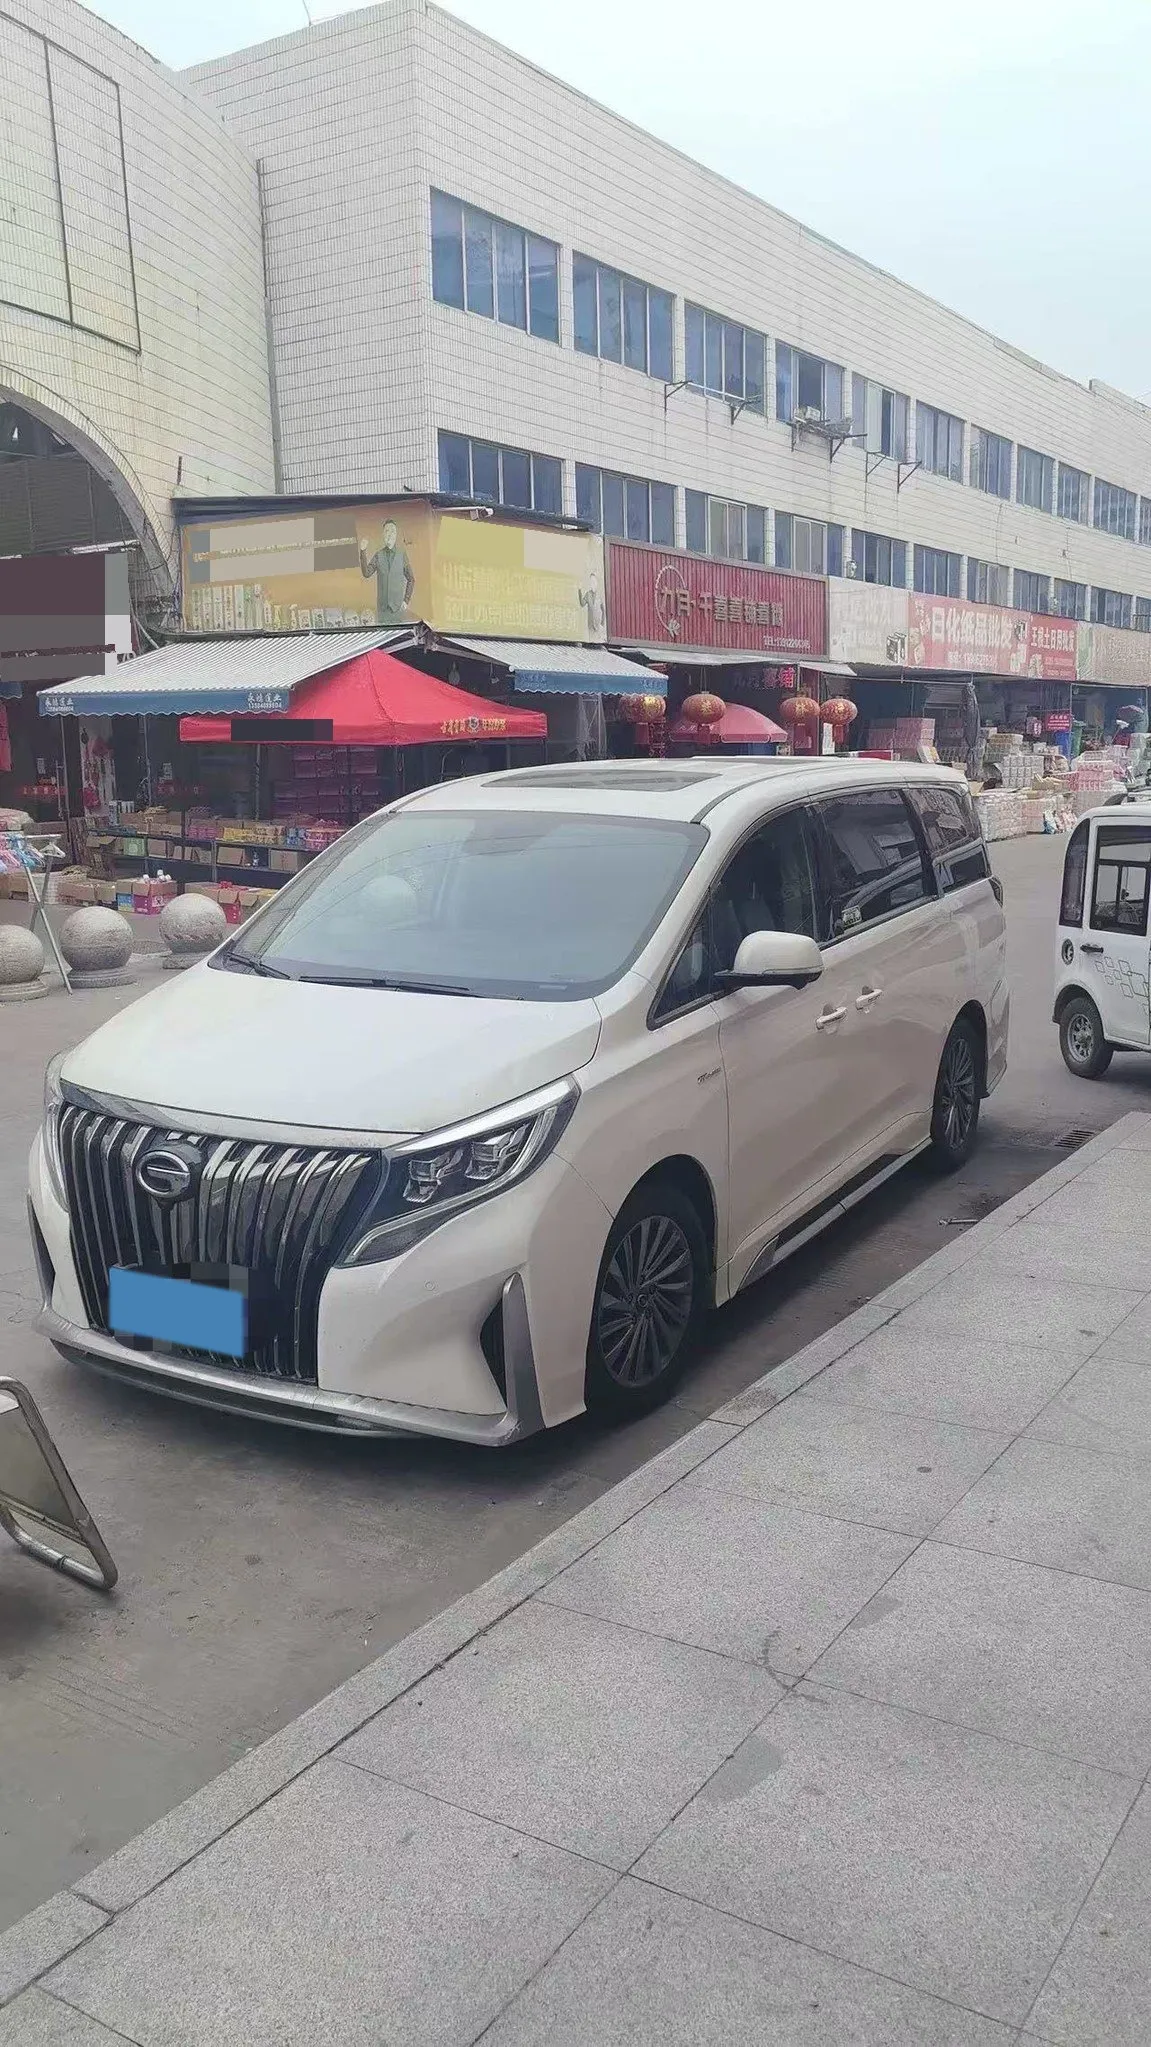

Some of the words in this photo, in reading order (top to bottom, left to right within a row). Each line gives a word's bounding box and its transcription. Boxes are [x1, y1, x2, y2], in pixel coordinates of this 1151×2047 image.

[931, 606, 1012, 648] 日化纸品批发
